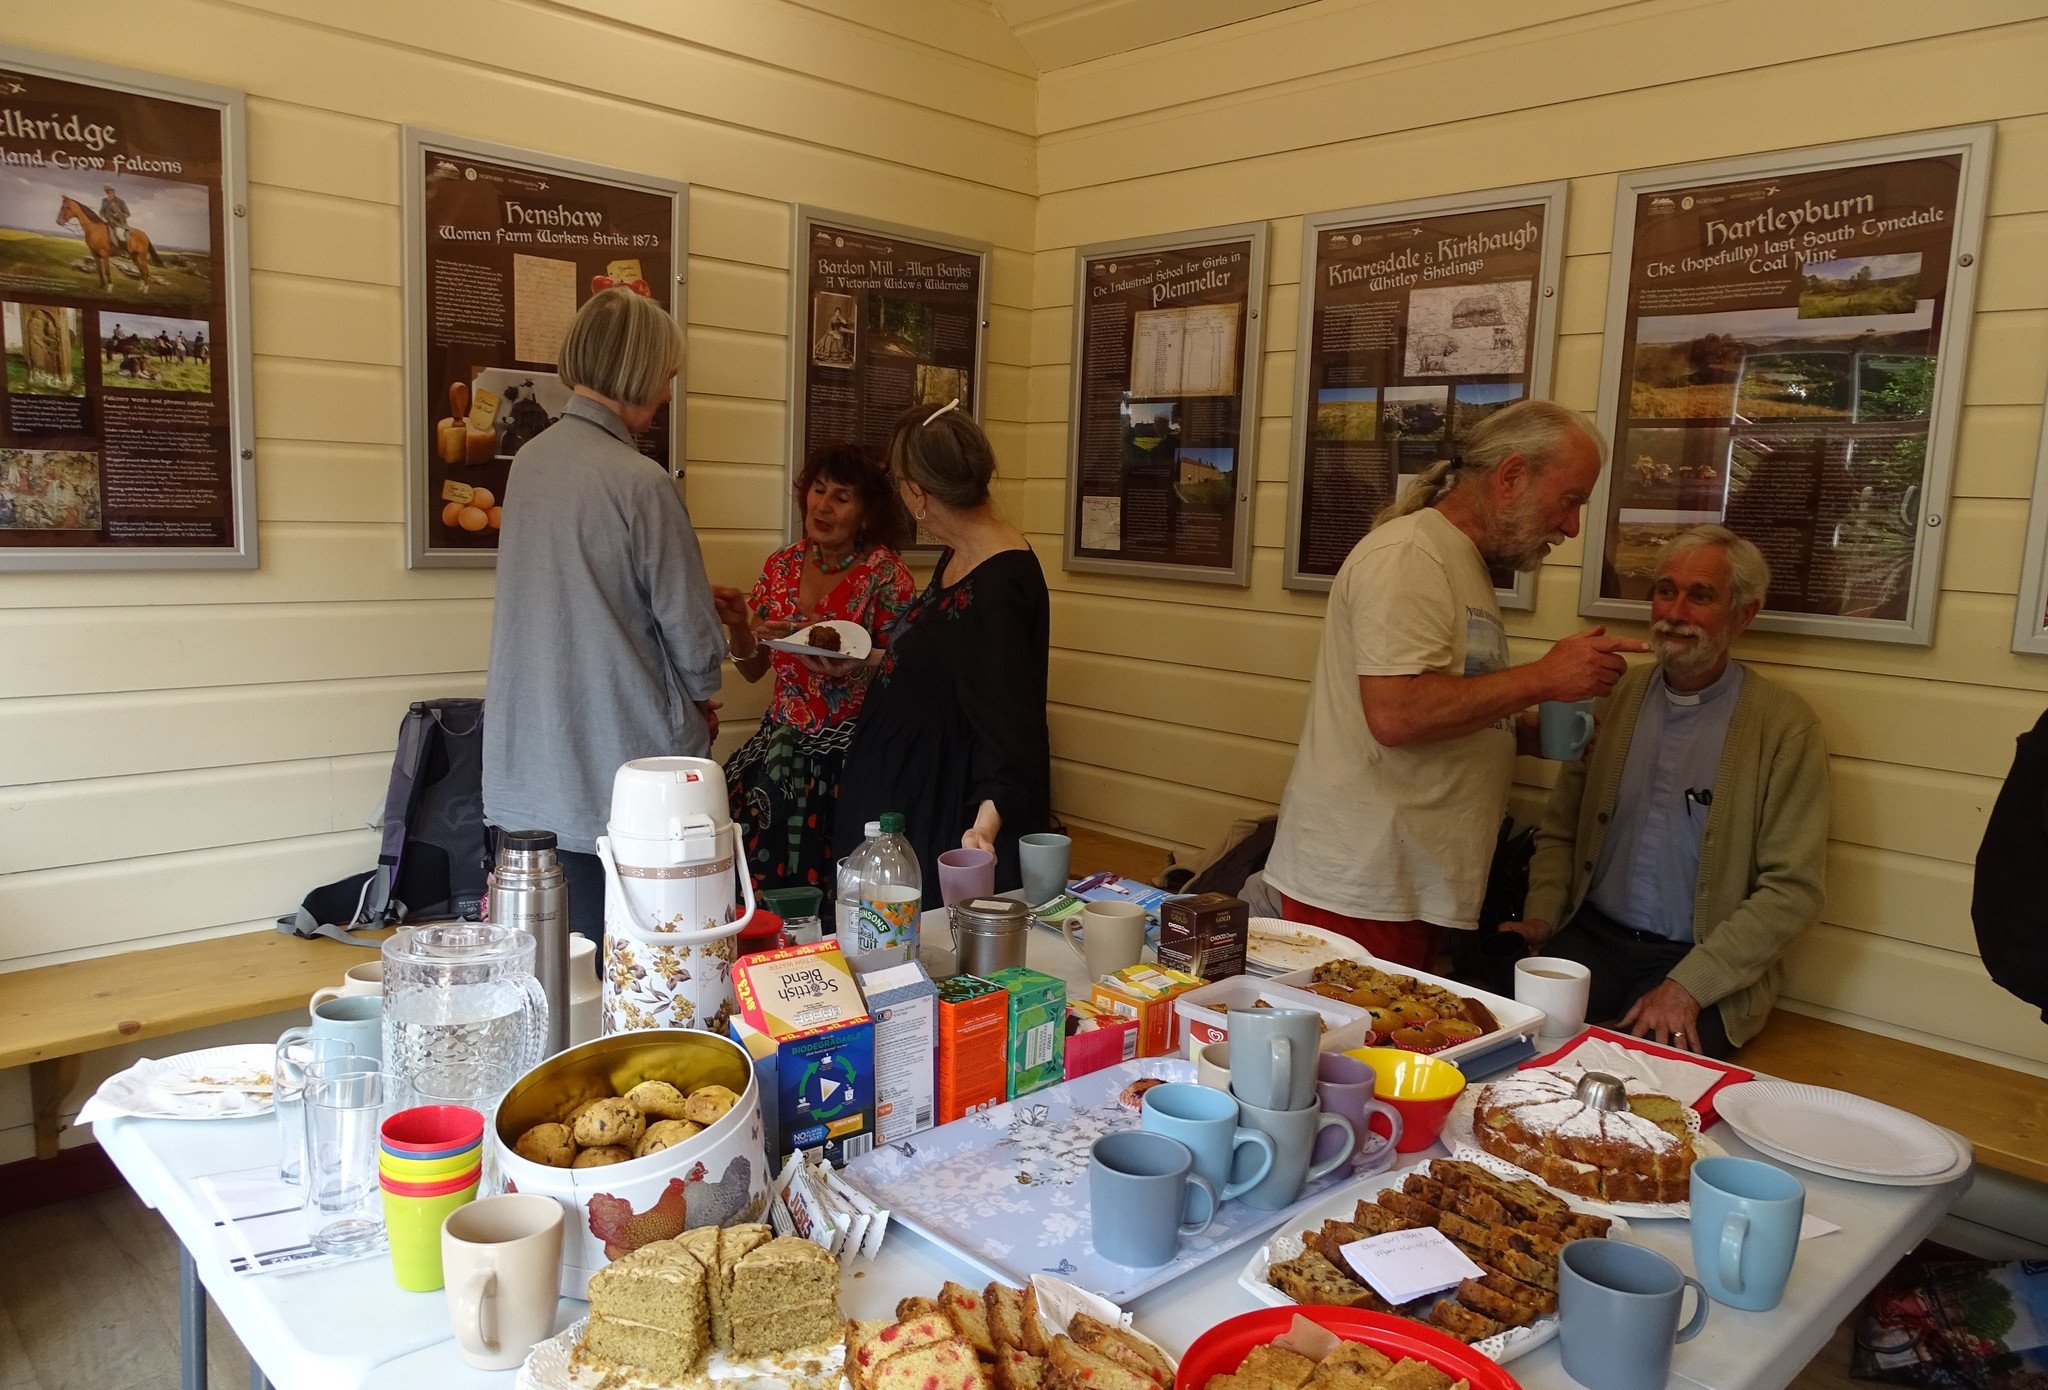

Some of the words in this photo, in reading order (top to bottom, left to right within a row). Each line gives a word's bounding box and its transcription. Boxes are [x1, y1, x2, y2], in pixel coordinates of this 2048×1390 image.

[51, 150, 105, 169] Crow
[113, 154, 182, 176] Falcons
[505, 201, 602, 227] Henshaw
[1705, 193, 1874, 246] Hartleyburn
[439, 225, 491, 242] Women
[496, 228, 532, 244] Farm
[537, 229, 589, 245] Workers
[593, 232, 629, 246] Strike
[632, 234, 659, 247] 1873
[1647, 260, 1676, 278] The
[1681, 243, 1759, 272] (hopefully)
[1765, 237, 1796, 256] last
[1802, 226, 1855, 249] South
[1861, 206, 1945, 237] Tynedale
[1328, 248, 1420, 287] Knaresdale
[1424, 251, 1434, 264] &
[1437, 221, 1538, 262] Kirkhaugh
[1749, 259, 1788, 275] Coal
[1794, 248, 1837, 270] Mine
[818, 258, 865, 275] Bardon
[869, 260, 894, 278] Mill
[906, 261, 934, 277] Allen
[937, 263, 972, 280] Banks
[1093, 286, 1107, 298] The
[1110, 275, 1153, 293] Industrial
[1156, 265, 1184, 282] School
[1187, 262, 1199, 274] for
[1202, 255, 1228, 269] Girls
[1231, 252, 1241, 262] in
[1369, 272, 1419, 293] Whitley
[1423, 258, 1484, 281] Shielings
[826, 277, 834, 288] A
[838, 277, 881, 289] Victorian
[884, 278, 922, 290] Widow's
[925, 279, 968, 291] Wilderness
[1152, 270, 1231, 308] Plenmeller
[781, 968, 823, 988] Blend
[793, 1131, 806, 1141] NO
